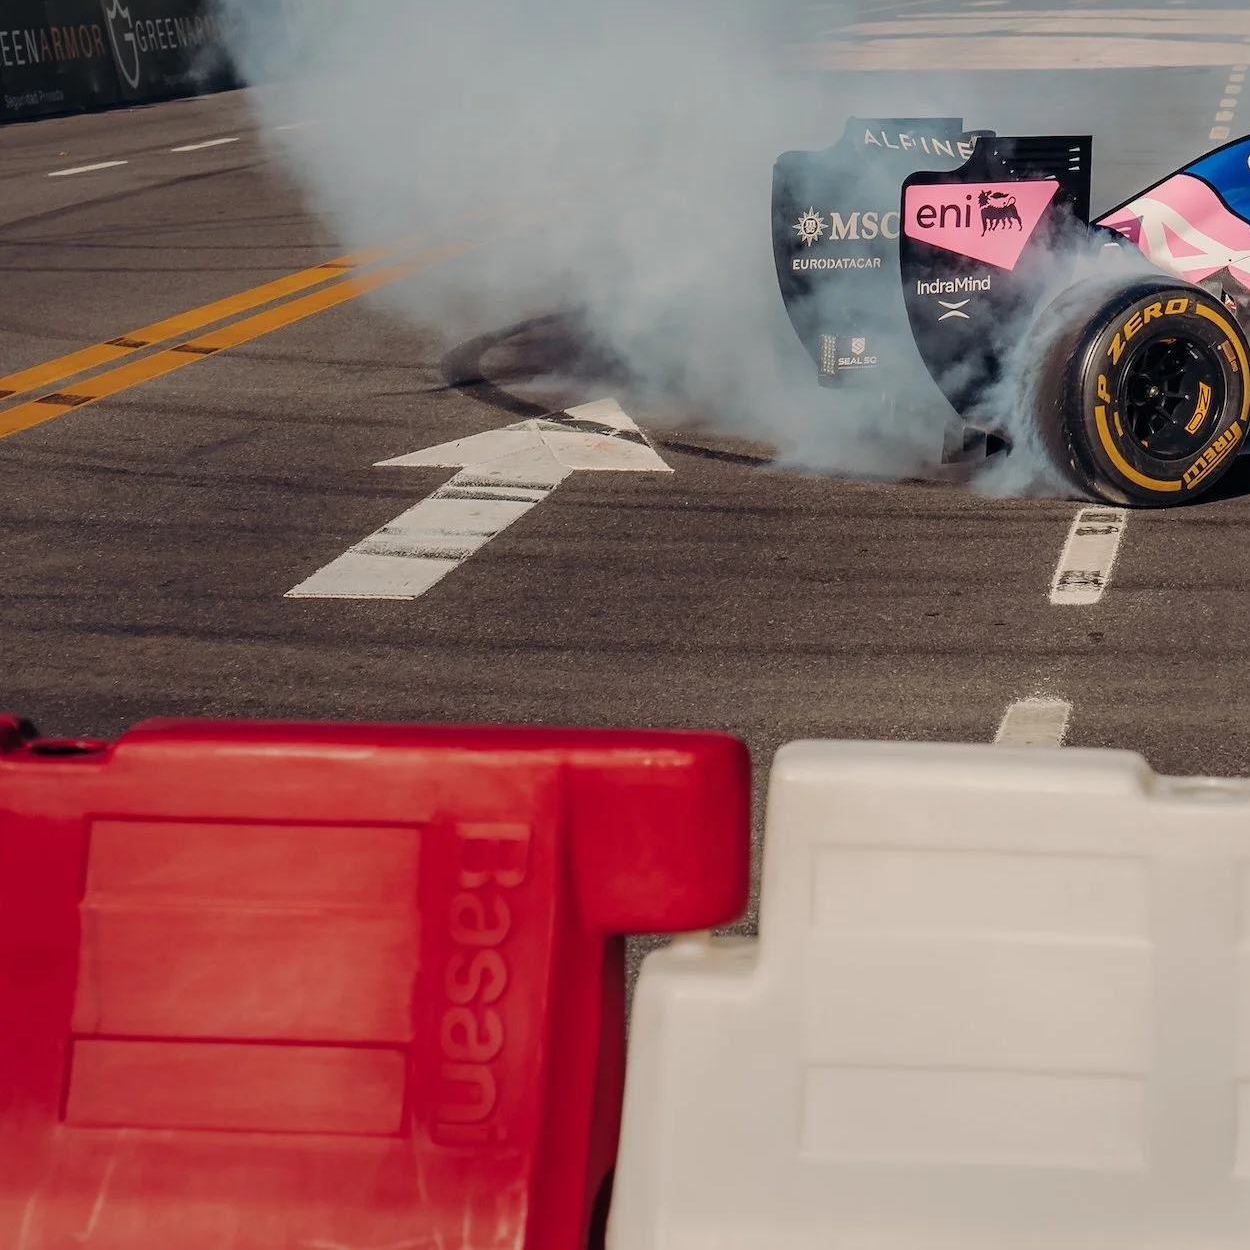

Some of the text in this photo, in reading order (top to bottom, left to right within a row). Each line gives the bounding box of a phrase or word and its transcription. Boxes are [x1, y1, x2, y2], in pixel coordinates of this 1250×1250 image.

[864, 129, 976, 160] ALPINE
[828, 211, 900, 240] MSC
[915, 194, 973, 229] eni
[792, 257, 881, 270] EURODATACAR
[916, 275, 991, 296] IndraMind
[1106, 298, 1190, 366] ZERO
[1182, 420, 1243, 490] PIRELLI
